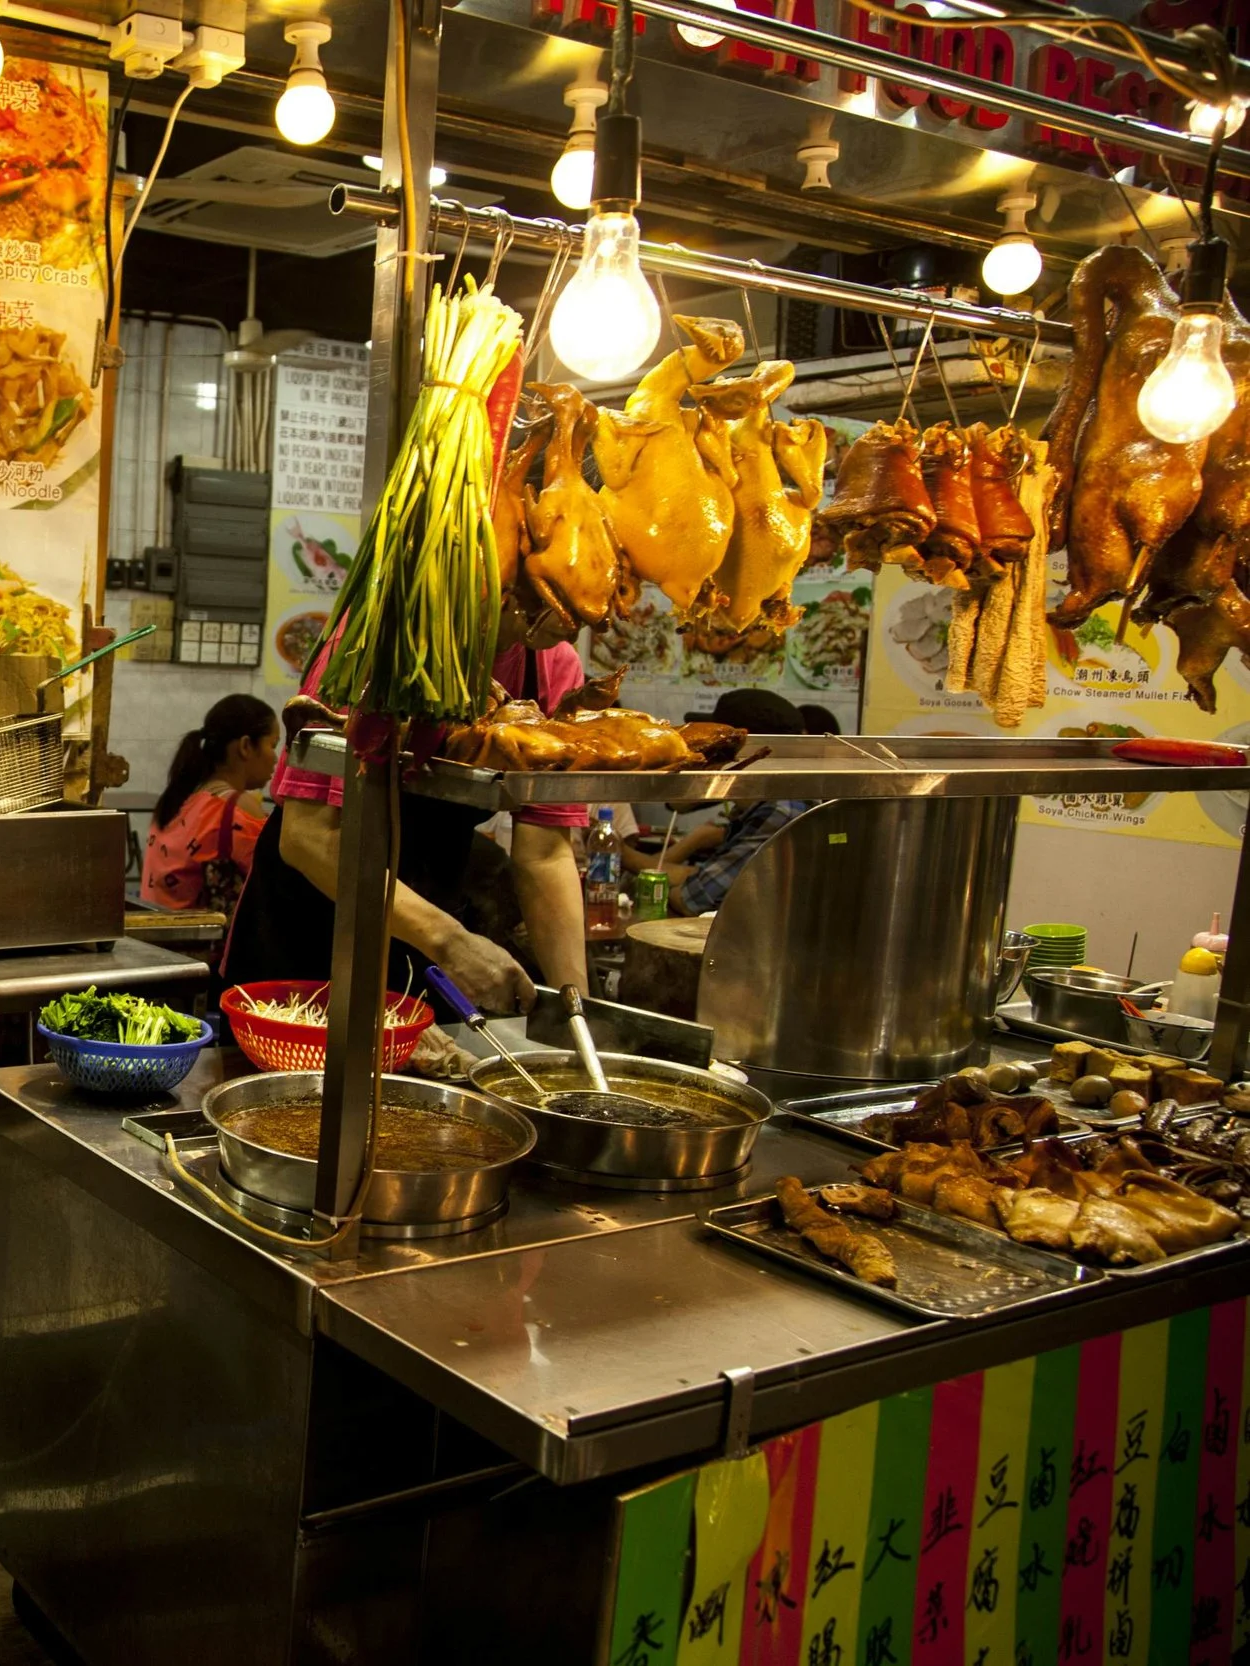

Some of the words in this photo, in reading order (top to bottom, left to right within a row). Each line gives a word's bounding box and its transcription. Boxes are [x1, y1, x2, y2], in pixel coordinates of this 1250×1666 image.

[41, 267, 88, 286] Crabs
[5, 483, 61, 499] Noodle
[1053, 687, 1081, 697] Chow
[1085, 688, 1128, 698] Steamed
[1135, 690, 1168, 700] Mullet
[919, 698, 940, 708] Soya
[943, 698, 972, 708] Goose
[1038, 805, 1063, 817] Soya
[1067, 808, 1108, 820] Chicken
[1113, 813, 1145, 825] Wings
